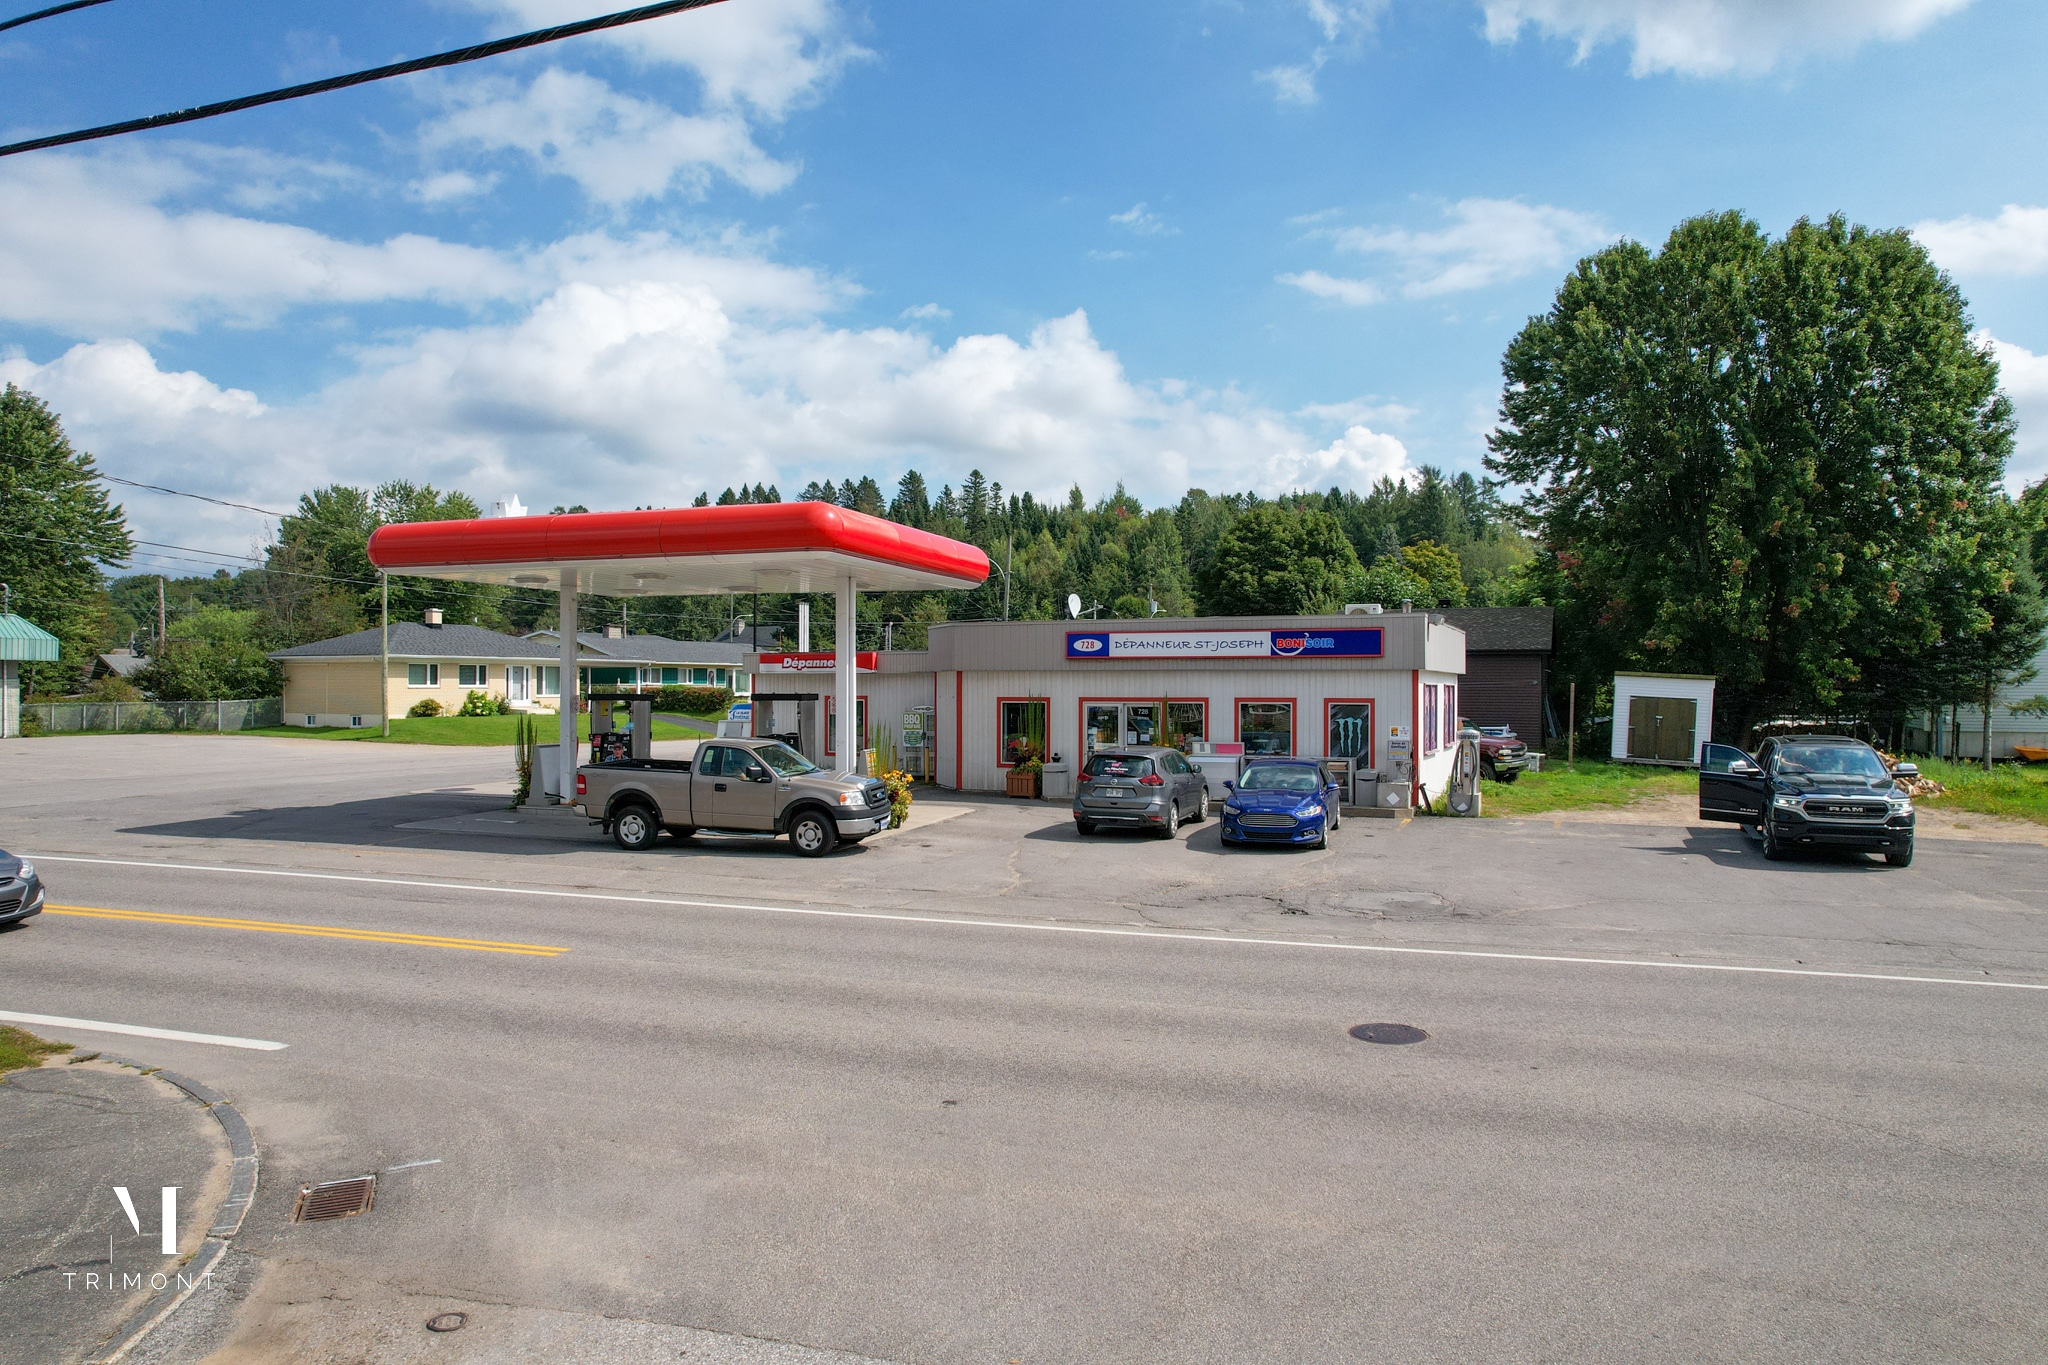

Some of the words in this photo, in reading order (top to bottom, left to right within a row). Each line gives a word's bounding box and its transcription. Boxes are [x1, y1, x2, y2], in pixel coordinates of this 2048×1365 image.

[1081, 641, 1095, 649] 728
[1114, 638, 1193, 649] DÉPANNEUR
[1194, 640, 1264, 651] ST-JOSEPH
[783, 657, 836, 669] Dépanne
[903, 714, 920, 724] BBQ
